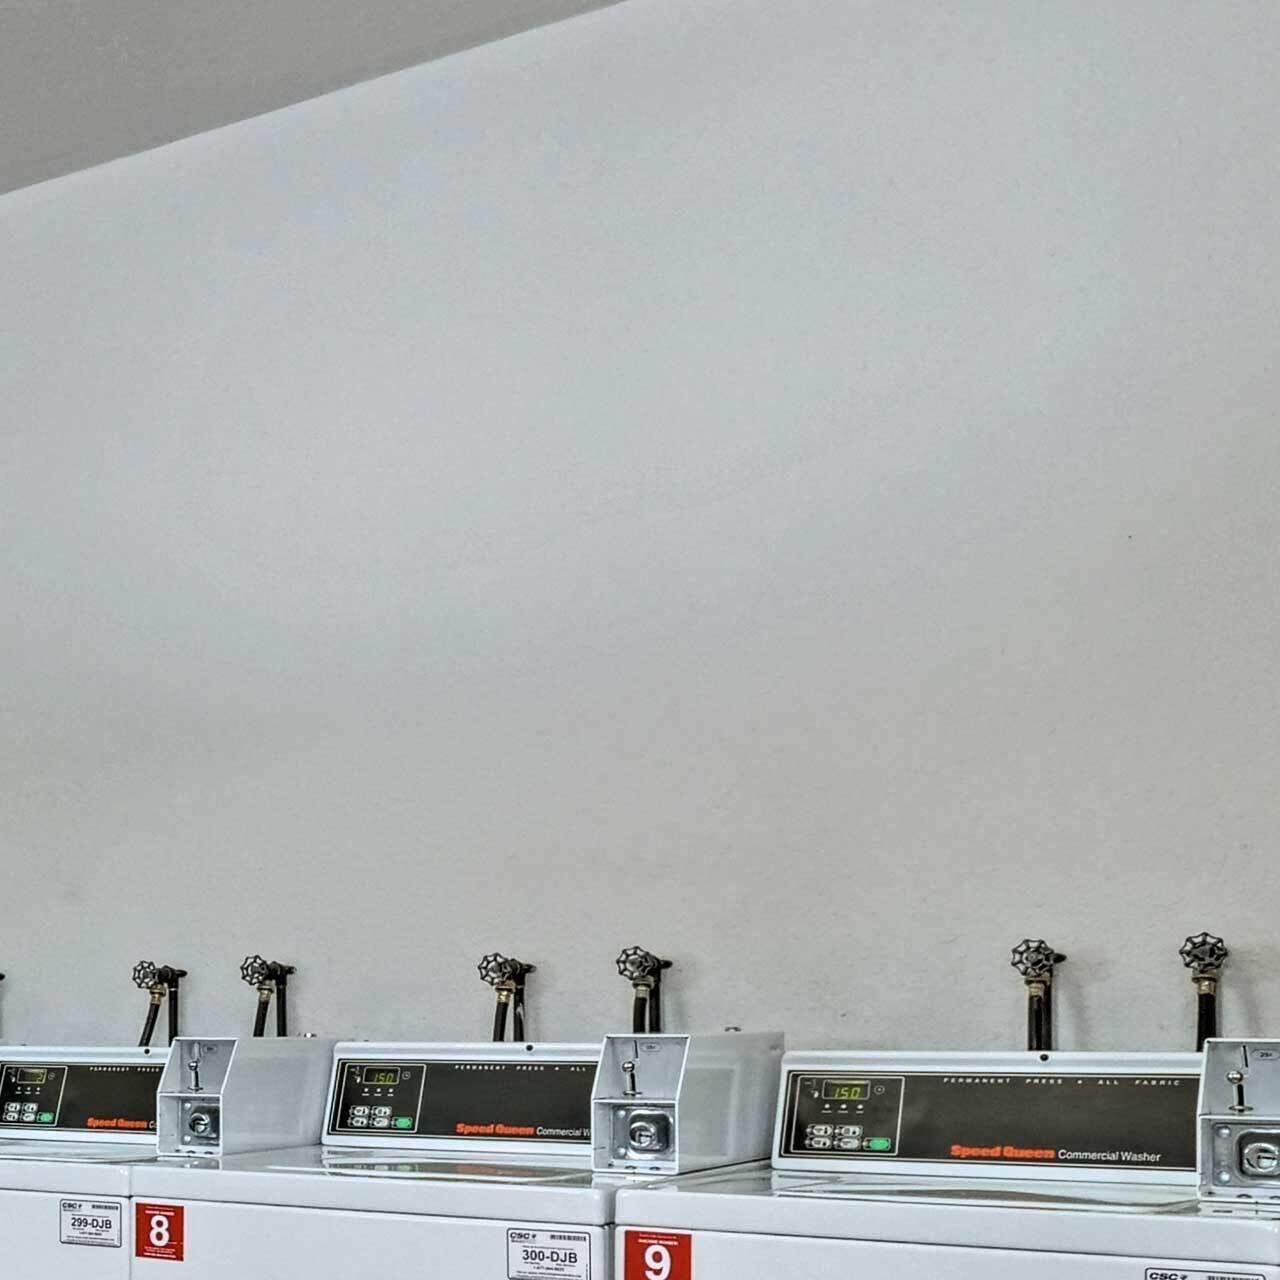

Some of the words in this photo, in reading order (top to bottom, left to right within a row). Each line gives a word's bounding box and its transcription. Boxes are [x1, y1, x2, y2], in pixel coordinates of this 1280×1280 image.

[87, 1117, 117, 1130] Speed
[118, 1119, 148, 1129] Queen
[456, 1123, 495, 1135] Speed
[495, 1124, 535, 1135] Queen
[536, 1126, 582, 1137] Commercial
[951, 1145, 1002, 1158] Speed
[1003, 1146, 1055, 1159] Queen
[1058, 1149, 1119, 1161] Commercial
[1121, 1151, 1162, 1162] Washer
[71, 1217, 112, 1229] 299-DJB
[149, 1215, 170, 1247] 8
[510, 1232, 530, 1240] CSC
[522, 1249, 578, 1264] 300-DJB
[1149, 1272, 1179, 1280] CSC
